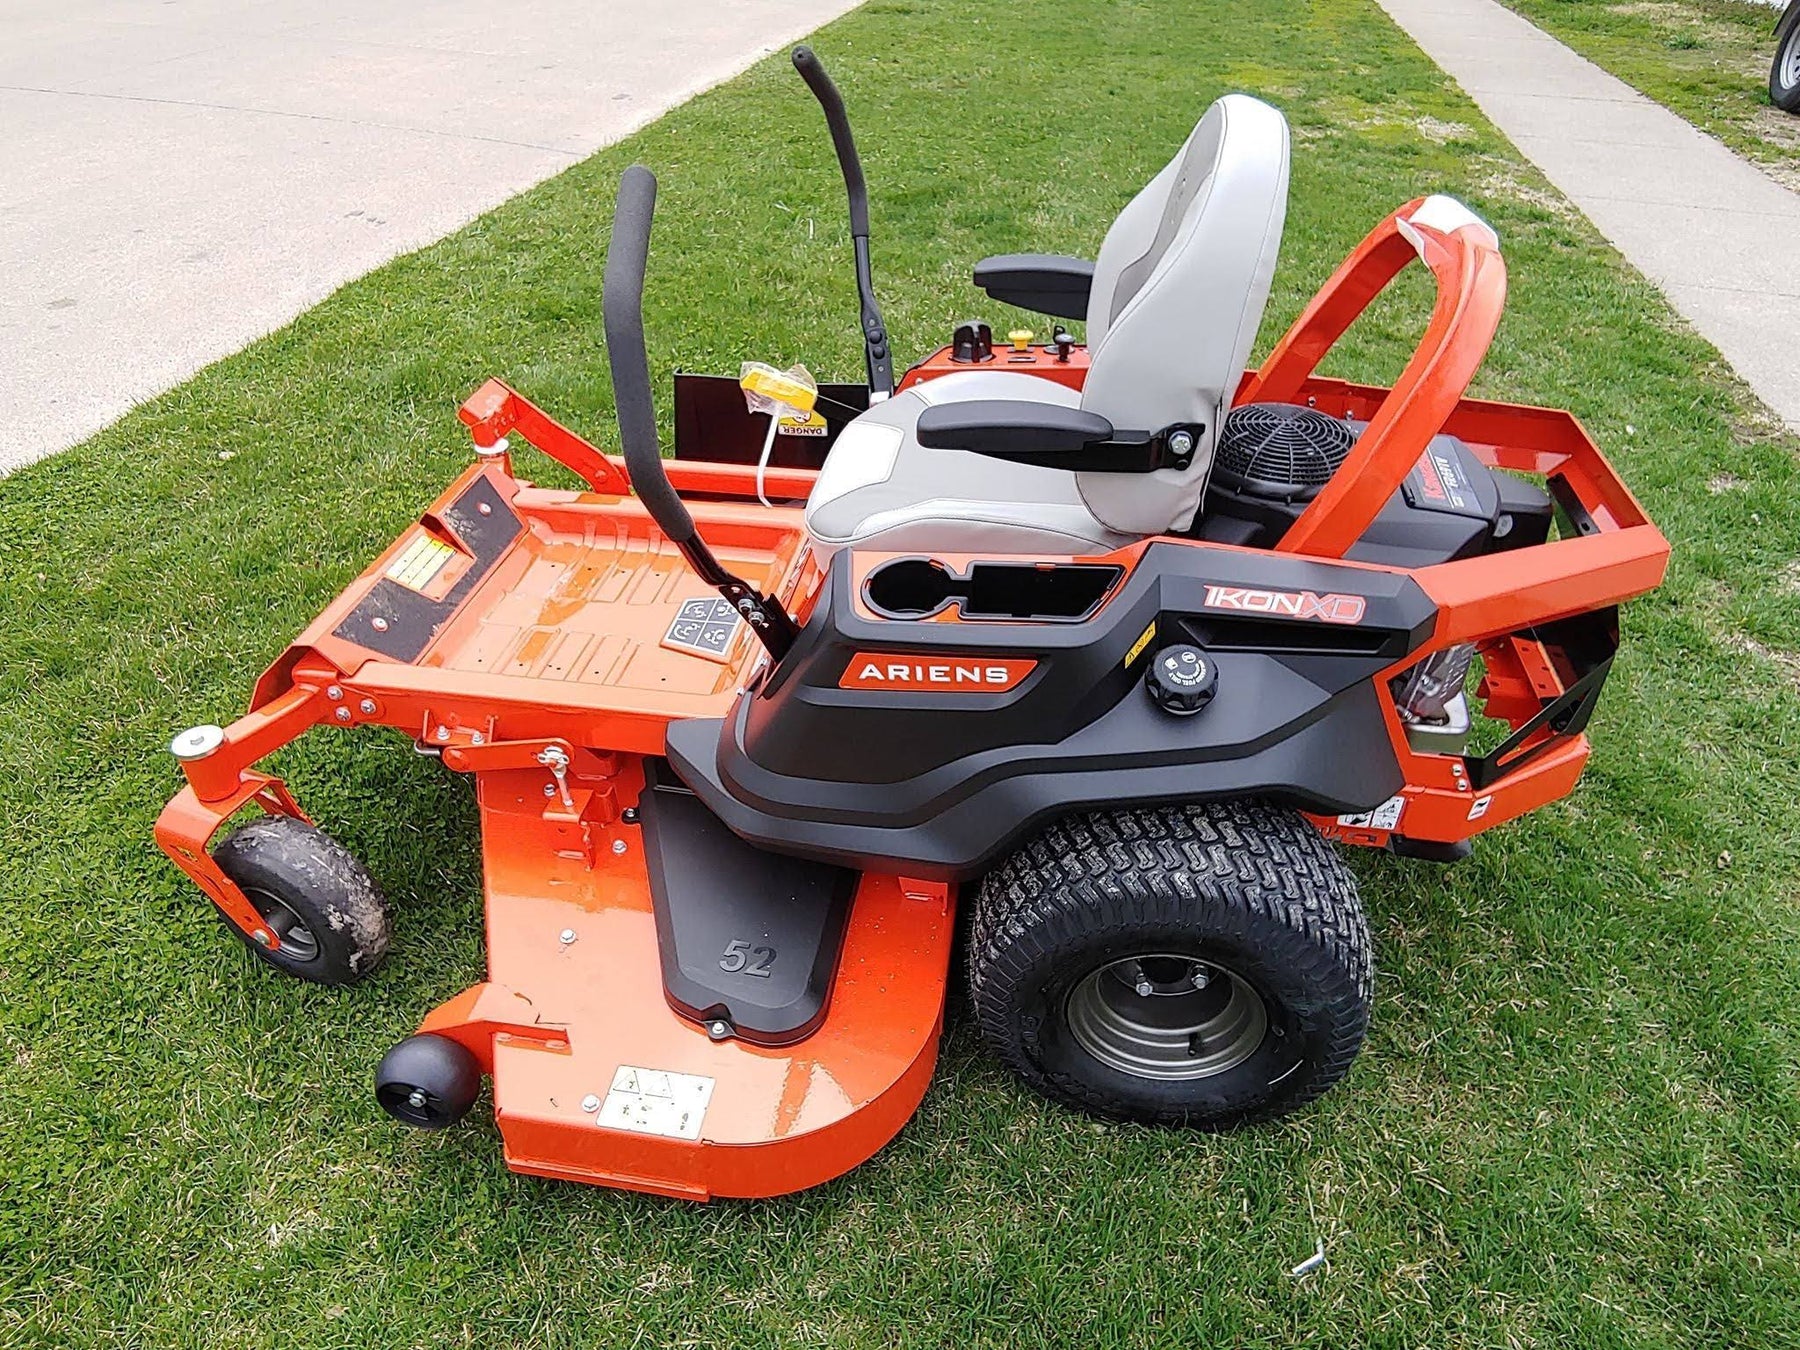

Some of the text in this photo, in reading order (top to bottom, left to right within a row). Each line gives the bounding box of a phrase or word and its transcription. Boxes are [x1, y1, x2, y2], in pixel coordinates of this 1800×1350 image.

[783, 427, 822, 435] DANGER
[858, 663, 1009, 683] ARIENS
[719, 940, 777, 978] 52
